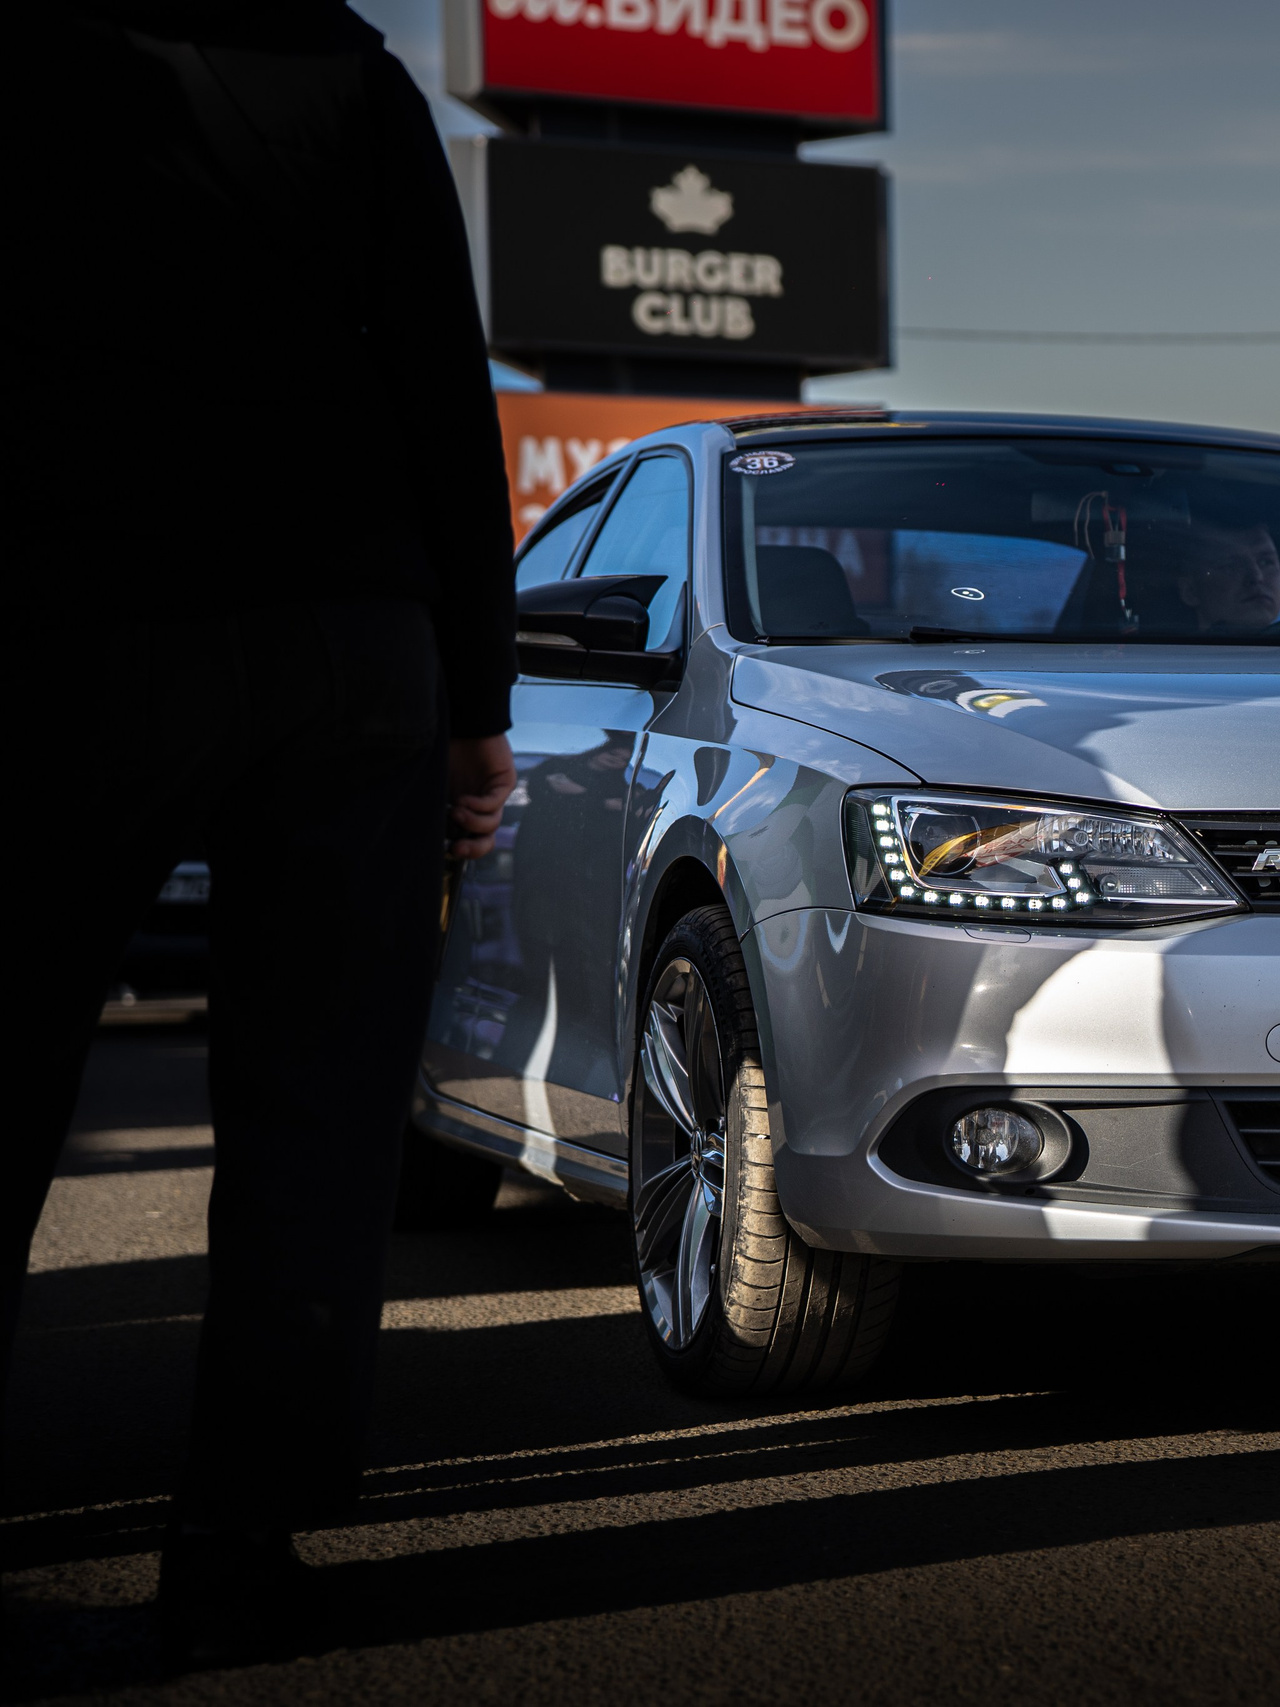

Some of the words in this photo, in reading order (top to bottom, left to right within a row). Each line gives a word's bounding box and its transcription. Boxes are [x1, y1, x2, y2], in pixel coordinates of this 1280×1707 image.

[602, 245, 782, 296] BURGER
[632, 291, 754, 339] CLUB
[746, 456, 779, 469] 36
